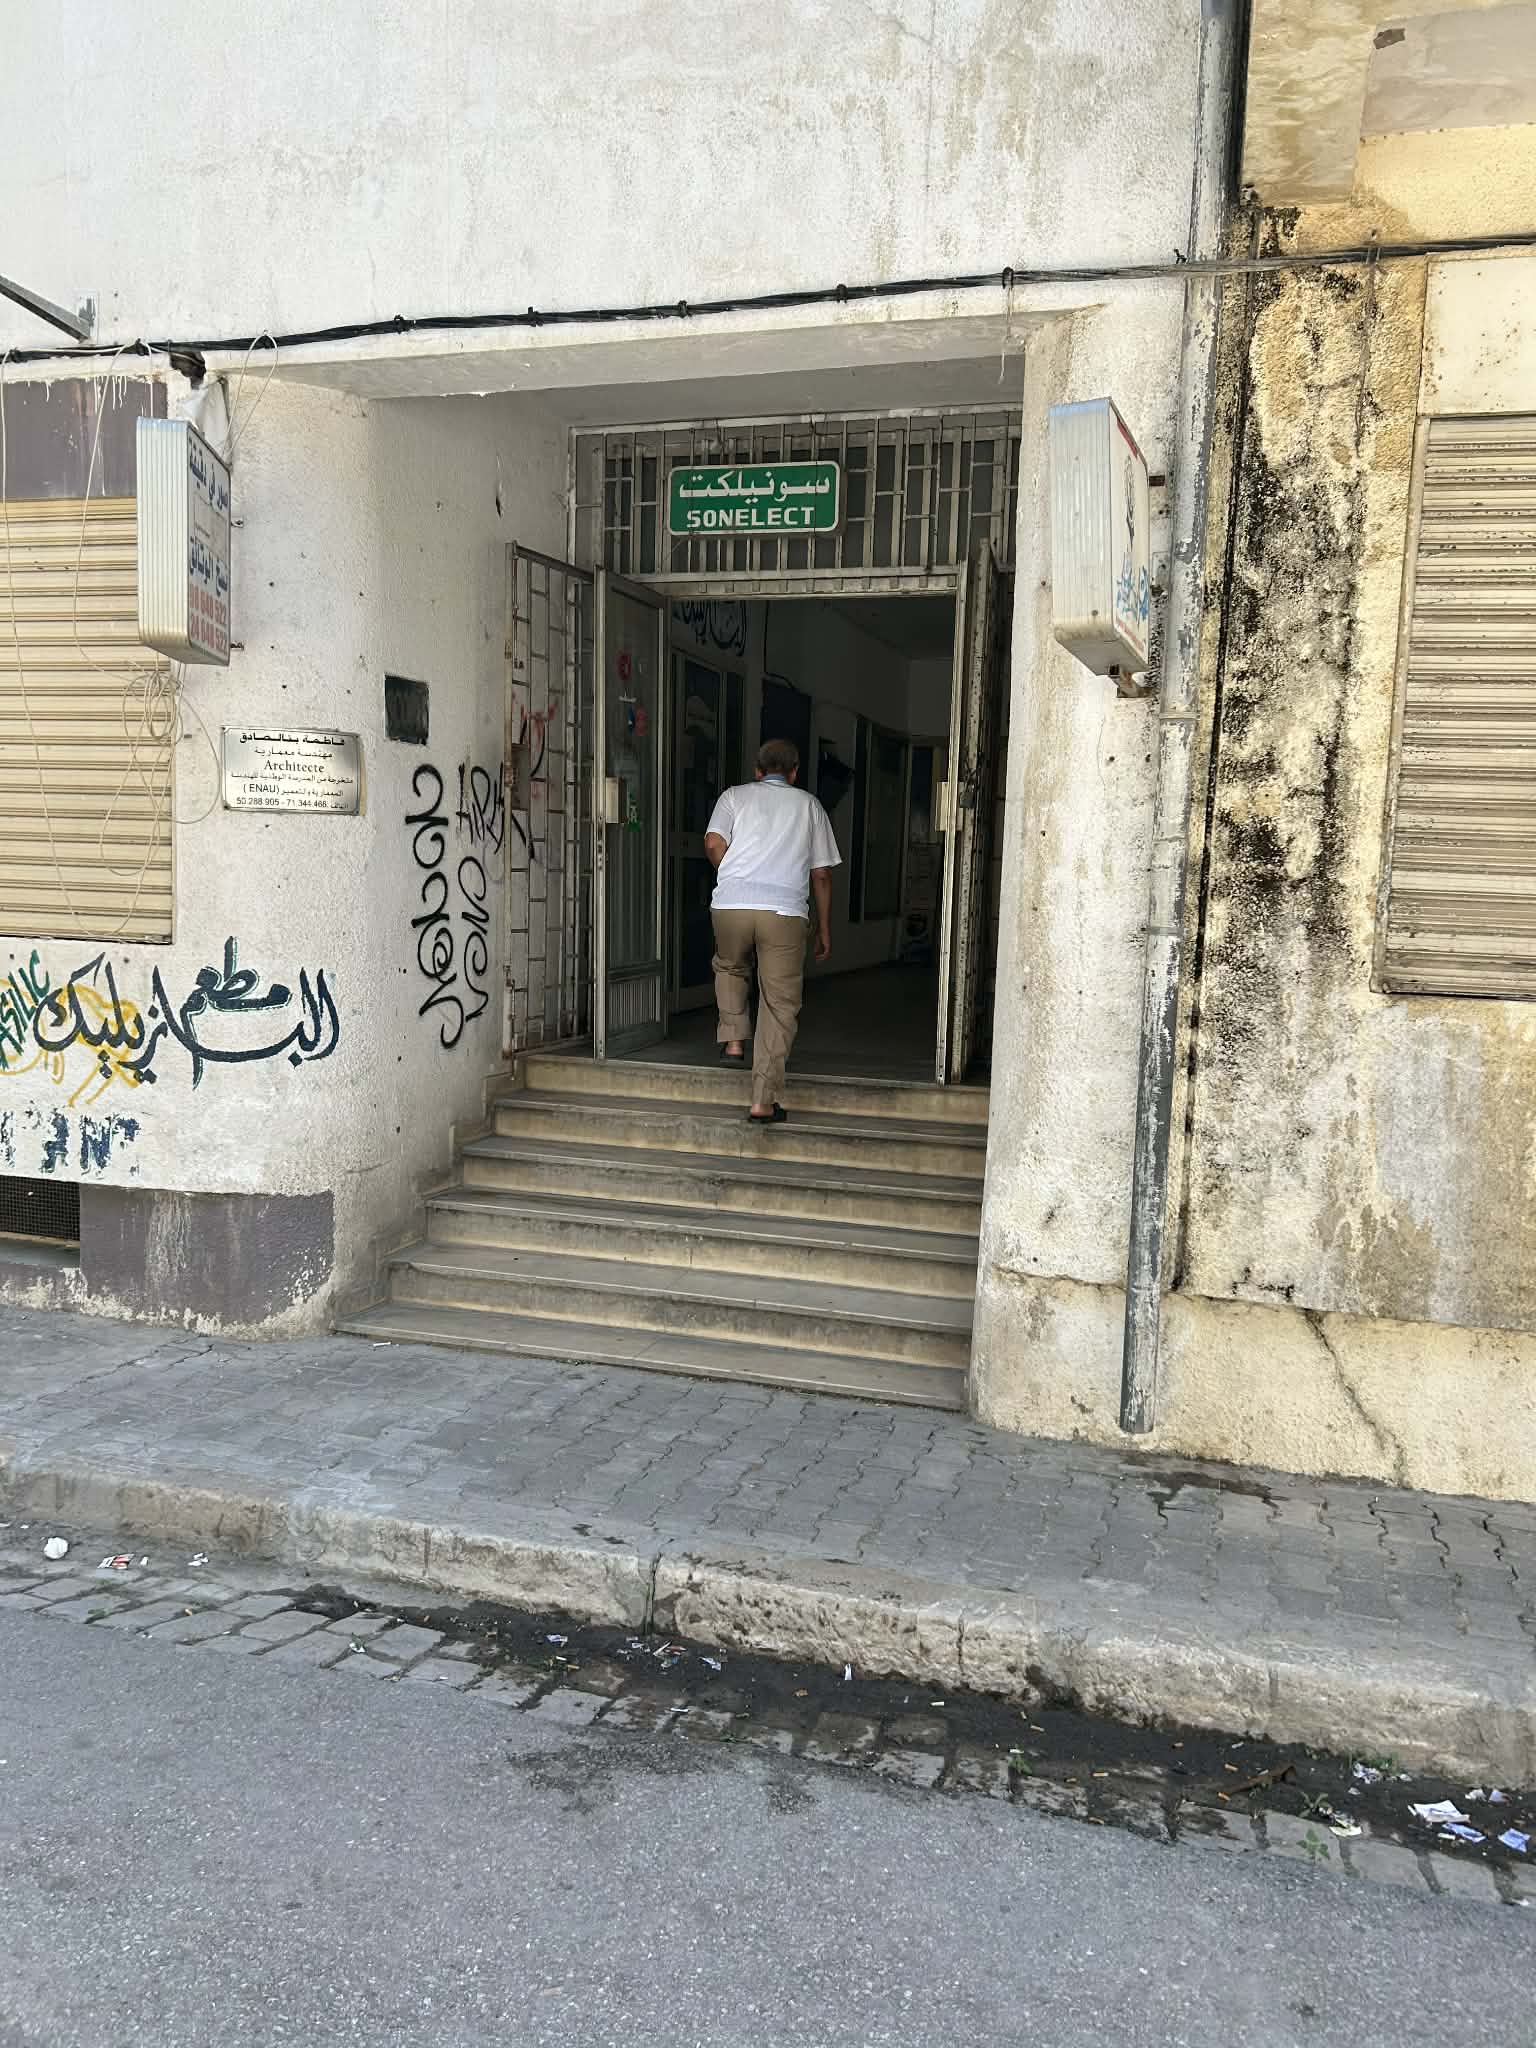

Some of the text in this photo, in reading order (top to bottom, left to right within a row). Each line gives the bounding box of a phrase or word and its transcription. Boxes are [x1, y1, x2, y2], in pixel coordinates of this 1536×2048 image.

[189, 437, 207, 489] دقيقة
[208, 464, 216, 506] في
[679, 470, 831, 504] سونيلكت
[686, 506, 815, 529] SONELECT
[190, 536, 228, 597] نسخ الوثائق
[254, 746, 333, 760] مهندسة معمارية
[302, 735, 345, 746] فاطمة
[264, 759, 325, 773] Architecte
[180, 936, 293, 1090] مطعم
